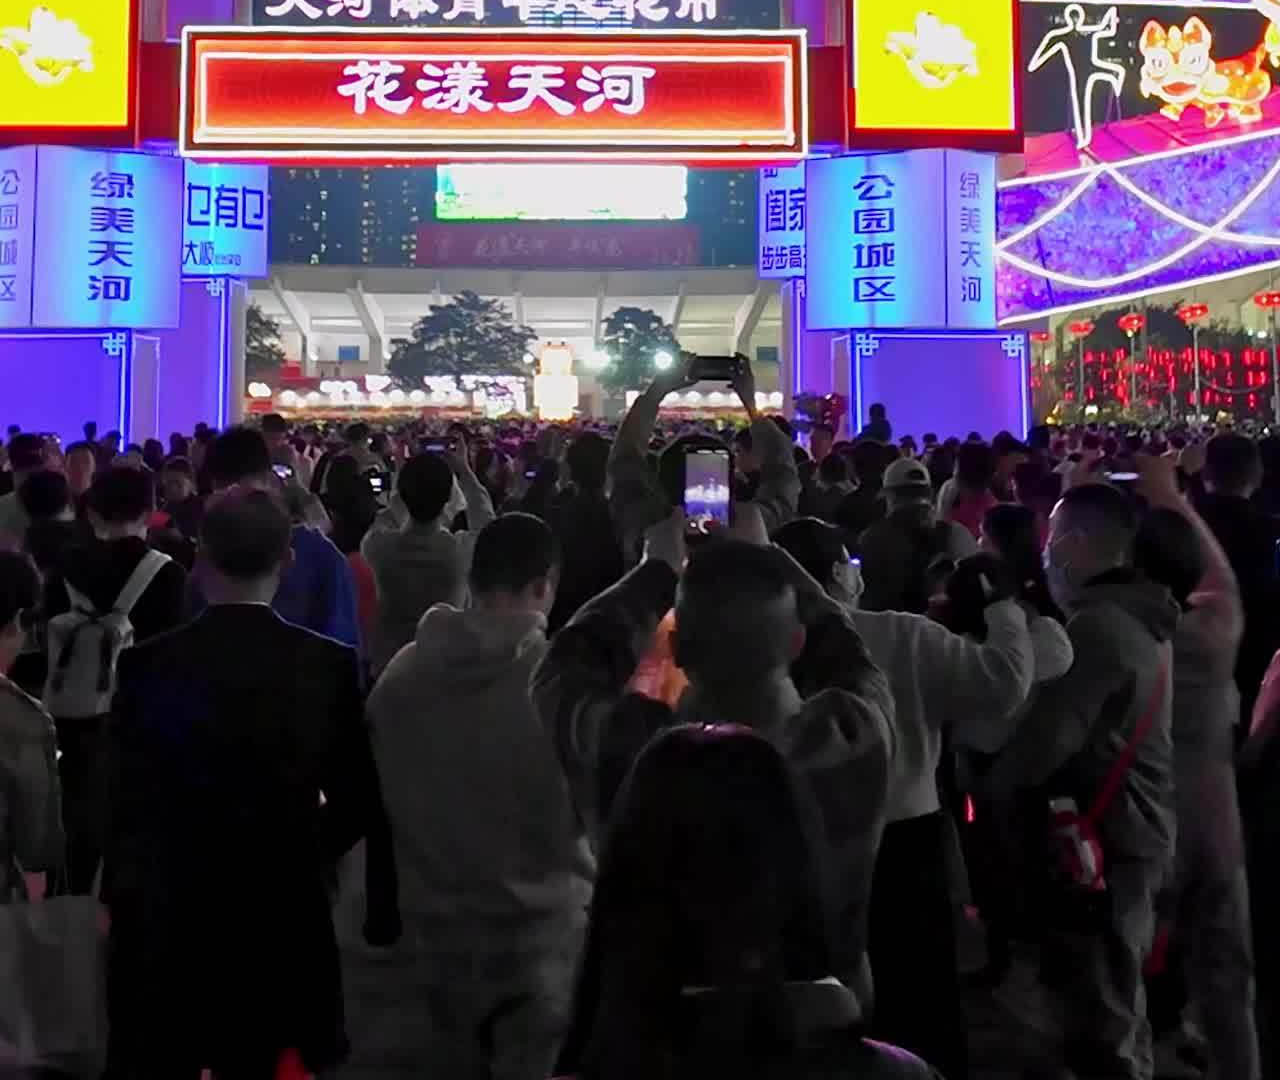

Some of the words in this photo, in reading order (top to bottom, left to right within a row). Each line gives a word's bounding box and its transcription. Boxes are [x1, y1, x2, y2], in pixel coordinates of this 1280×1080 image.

[337, 60, 656, 116] 花漾天河
[87, 171, 135, 302] 绿美天河
[852, 173, 896, 303] 公园城区
[959, 171, 982, 303] 绿美天河
